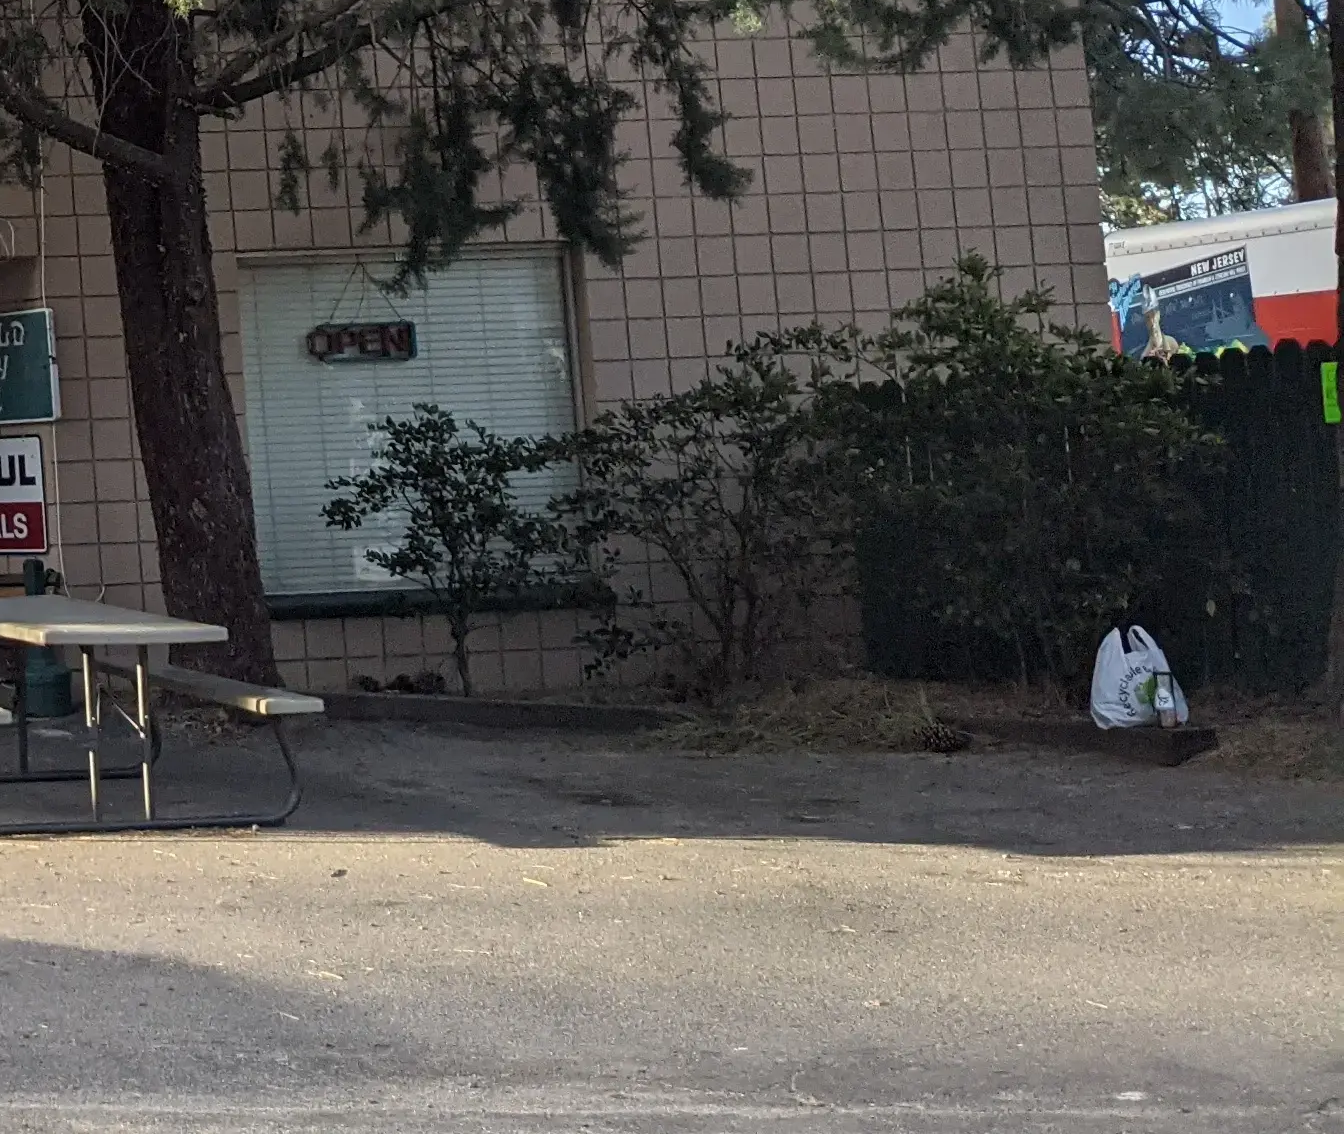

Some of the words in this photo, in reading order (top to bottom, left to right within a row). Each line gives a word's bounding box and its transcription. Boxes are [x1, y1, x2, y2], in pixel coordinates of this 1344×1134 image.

[1190, 260, 1211, 276] NEW
[1212, 248, 1245, 271] JERSEY
[305, 326, 410, 357] OPEN
